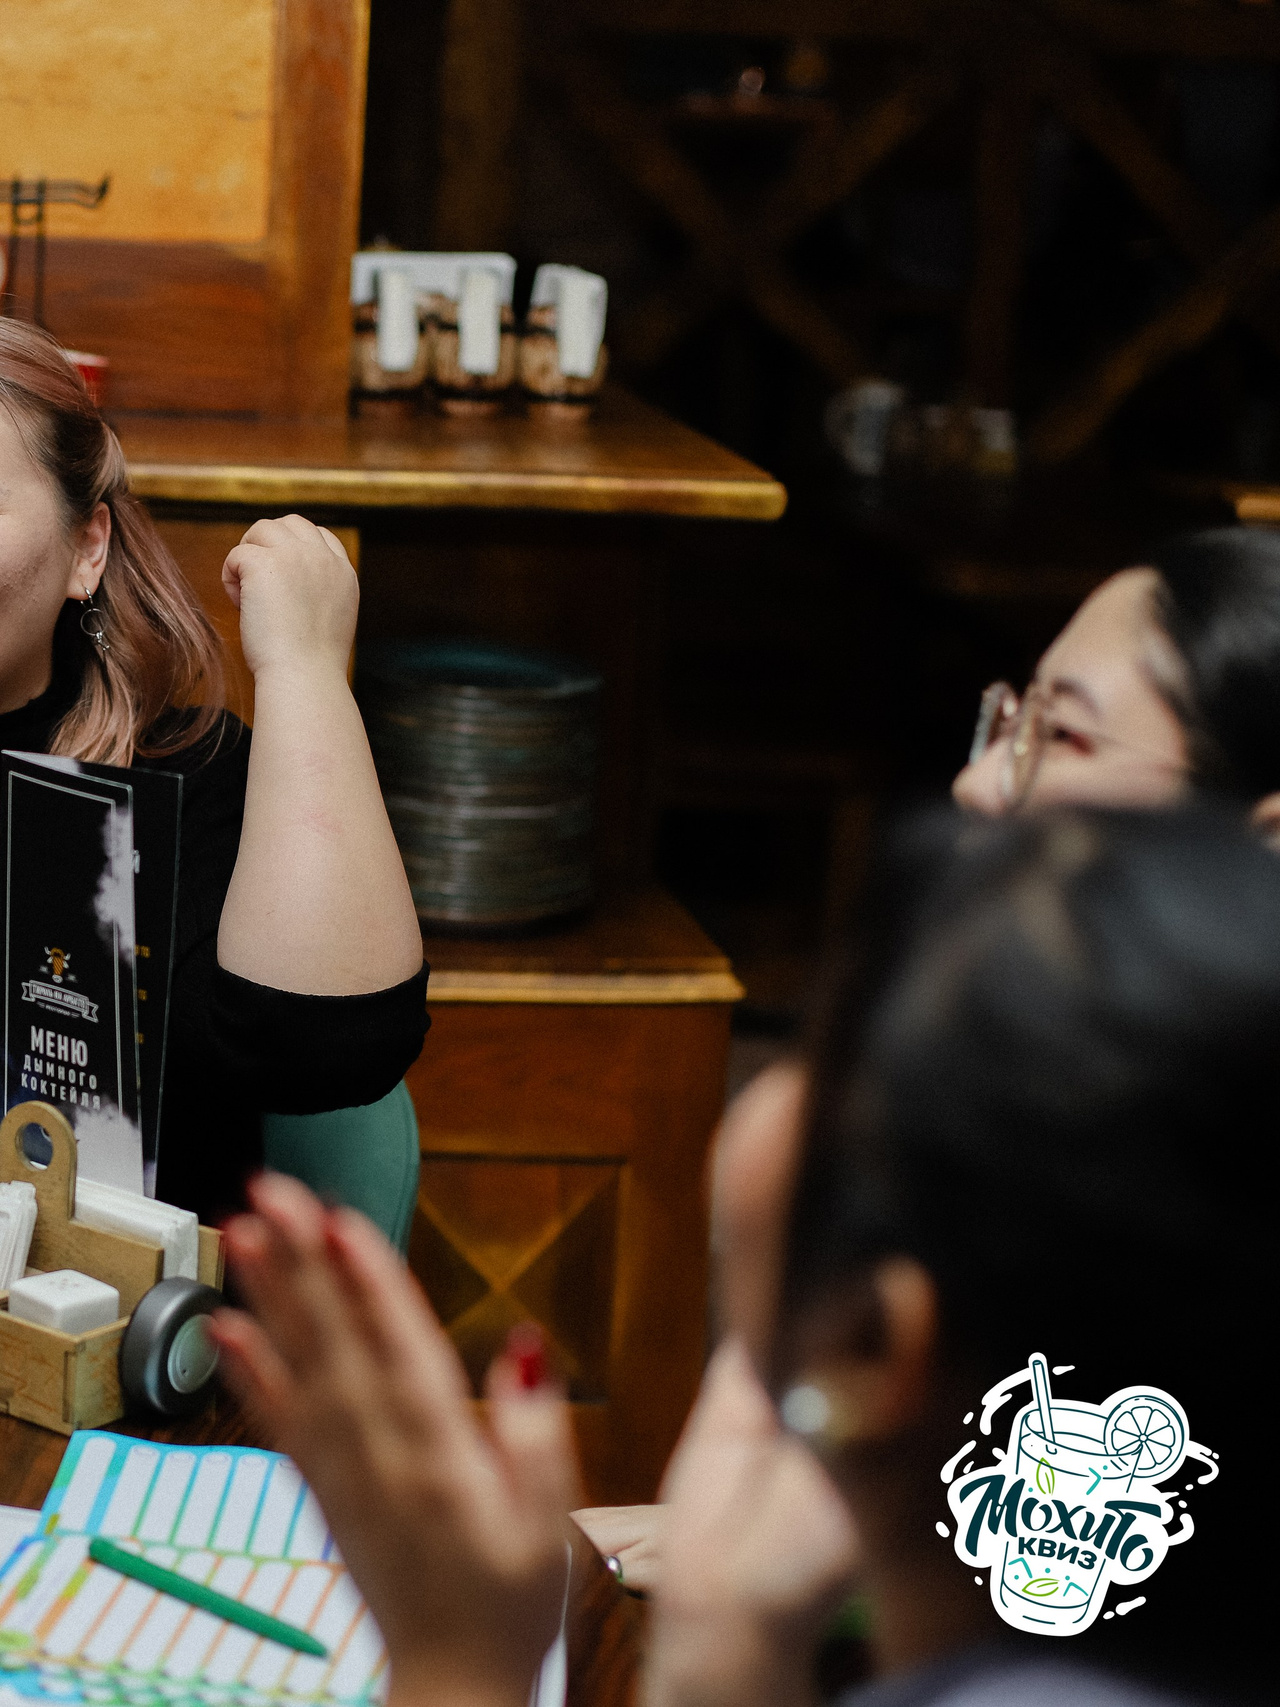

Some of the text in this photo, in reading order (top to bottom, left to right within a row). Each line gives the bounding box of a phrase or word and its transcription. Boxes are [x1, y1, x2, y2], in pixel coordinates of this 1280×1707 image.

[30, 1025, 89, 1067] МЕНЮ
[23, 1054, 98, 1090] ДЫМНОГО
[21, 1073, 101, 1110] КОКТЕЙЛЯ
